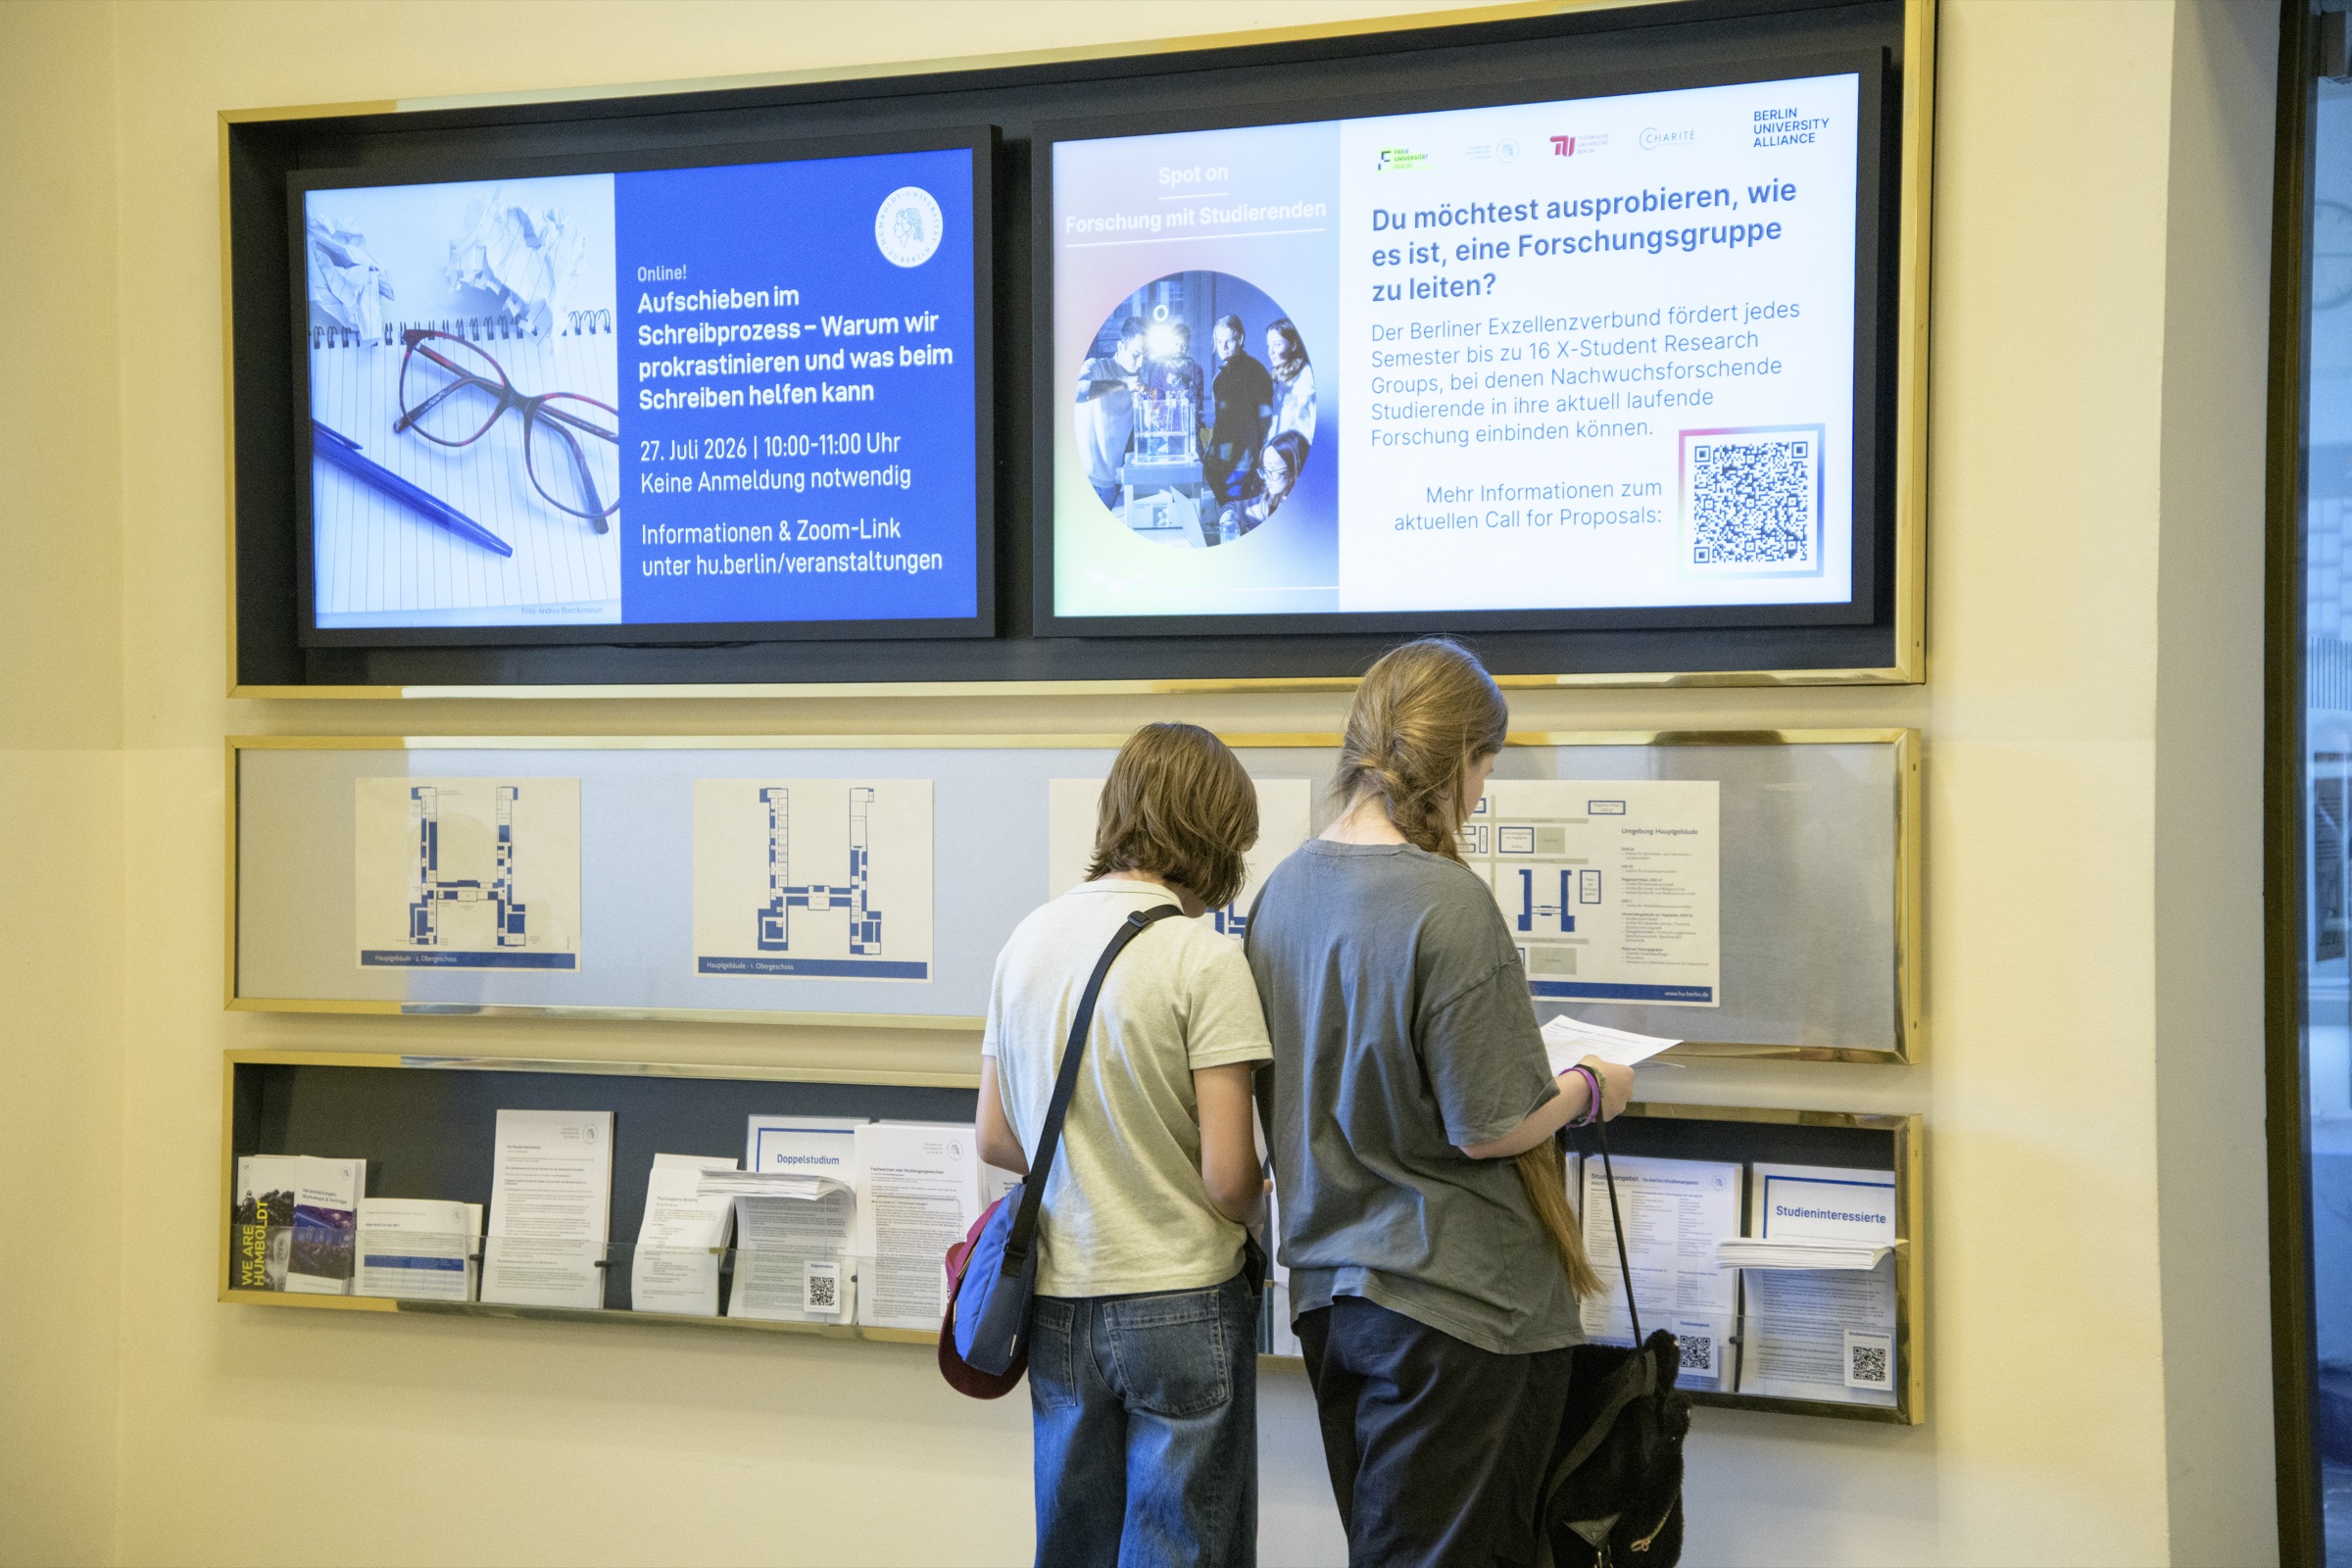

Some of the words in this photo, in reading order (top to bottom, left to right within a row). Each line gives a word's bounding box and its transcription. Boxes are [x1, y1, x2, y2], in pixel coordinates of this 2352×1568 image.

[1753, 109, 1797, 122] BERLIN
[1753, 119, 1829, 134] UNIVERSITY
[1645, 129, 1695, 144] CHARITÉ
[1753, 132, 1816, 148] ALLIANCE
[1158, 166, 1200, 187] Spot
[1205, 165, 1228, 181] on
[1065, 214, 1161, 233] Forschung
[1166, 208, 1195, 226] mit
[1200, 201, 1326, 224] Studierenden
[1373, 209, 1406, 230] Du
[1414, 198, 1539, 227] möchtest
[1546, 185, 1739, 221] ausprobieren,
[1747, 178, 1796, 205] wie
[1372, 247, 1401, 266] es
[1408, 241, 1446, 267] ist,
[1455, 236, 1510, 260] eine
[1519, 219, 1782, 257] Forschungsgruppe
[637, 265, 687, 282] Online!
[1372, 281, 1402, 302] zu
[1408, 272, 1496, 300] leiten?
[637, 287, 769, 314] Aufschieben
[773, 286, 800, 306] im
[638, 321, 802, 346] Schreibprozess
[821, 316, 899, 337] Warum
[905, 311, 939, 332] wir
[1372, 324, 1404, 342] Der
[1410, 320, 1482, 340] Berliner
[1489, 310, 1661, 335] Exzellenzverbund
[1668, 306, 1738, 326] fördert
[1744, 301, 1800, 325] jedes
[639, 355, 800, 381] prokrastinieren
[805, 350, 844, 370] und
[849, 350, 894, 369] was
[900, 344, 953, 367] beim
[1372, 349, 1460, 368] Semester
[1467, 345, 1494, 364] bis
[1500, 347, 1522, 361] zu
[1530, 343, 1550, 360] 16
[1556, 336, 1657, 358] X-Student
[1665, 330, 1759, 352] Research
[1372, 375, 1444, 395] Groups,
[1450, 372, 1479, 391] bei
[1485, 370, 1544, 389] denen
[1551, 357, 1783, 385] Nachwuchsforschende
[639, 386, 744, 410] Schreiben
[749, 384, 817, 406] helfen
[821, 381, 874, 403] kann
[1372, 399, 1485, 420] Studierende
[1492, 398, 1507, 416] in
[1514, 395, 1549, 415] ihre
[1556, 392, 1620, 413] aktuell
[1627, 388, 1713, 409] laufende
[640, 441, 664, 462] 27.
[669, 439, 698, 460] Juli
[704, 437, 747, 459] 2026
[764, 433, 861, 457] 10:00-11:00
[866, 432, 901, 454] Uhr
[1372, 427, 1469, 447] Forschung
[1476, 422, 1569, 442] einbinden
[1576, 419, 1653, 439] können.
[641, 472, 693, 493] Keine
[698, 468, 805, 491] Anmeldung
[810, 465, 911, 489] notwendig
[1427, 486, 1474, 504] Mehr
[1481, 482, 1614, 502] Informationen
[1621, 480, 1662, 498] zum
[642, 521, 772, 545] Informationen
[778, 520, 791, 542] &
[797, 518, 901, 541] Zoom-Link
[1395, 513, 1479, 531] aktuellen
[1485, 511, 1520, 528] Call
[1527, 510, 1553, 526] for
[1559, 507, 1662, 529] Proposals:
[642, 556, 691, 576] unter
[696, 550, 942, 576] hu.berlin/veranstaltungen
[777, 1153, 840, 1165] Doppelstudium
[1776, 1205, 1886, 1224] Studieninteressierte
[243, 1225, 254, 1257] ARE
[254, 1200, 268, 1286] HUMBOLDT
[242, 1260, 253, 1286] WE
